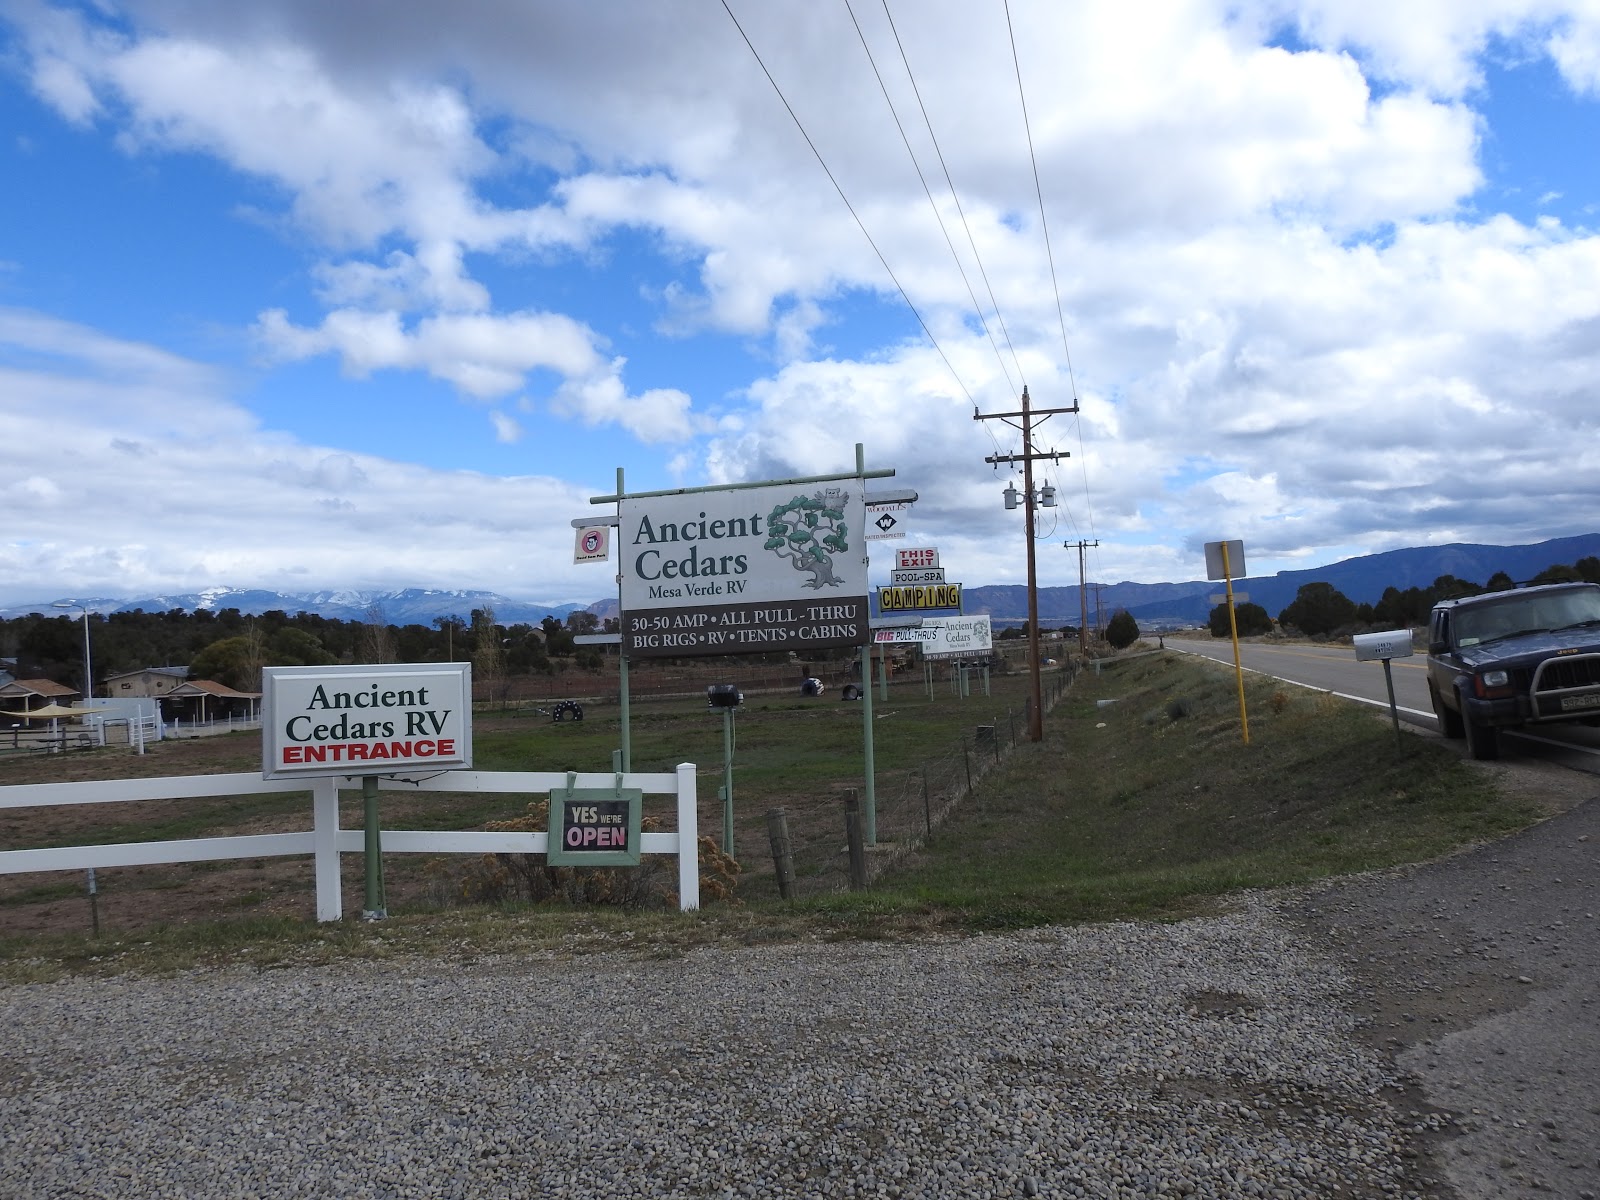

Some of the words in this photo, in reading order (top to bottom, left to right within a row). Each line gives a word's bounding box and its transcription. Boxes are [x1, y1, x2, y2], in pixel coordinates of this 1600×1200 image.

[632, 511, 763, 545] Ancient
[880, 518, 893, 528] W
[635, 545, 748, 581] Cedars
[900, 549, 935, 558] THIS
[901, 558, 934, 567] EXIT
[895, 572, 942, 582] POOL-SPA
[648, 585, 682, 599] Mesa
[684, 581, 723, 597] Verde
[726, 579, 748, 594] RV
[882, 587, 957, 607] CAMPING
[631, 616, 671, 632] 30-50
[672, 613, 708, 629] AMP
[719, 611, 751, 626] ALL
[945, 621, 972, 631] Ancient
[633, 634, 660, 649] BIG
[662, 632, 697, 647] RIGS
[707, 630, 728, 645] RV
[736, 627, 788, 643] TENTS
[798, 623, 857, 640] CABINS
[876, 631, 894, 642] BIG
[946, 632, 970, 642] Cedars
[306, 683, 430, 710] Ancient
[285, 712, 395, 742] Cedars
[404, 709, 452, 737] RV
[282, 738, 456, 764] ENTRANCE
[571, 806, 598, 824] YES
[600, 814, 622, 824] WE'RE
[566, 826, 626, 847] OPEN
